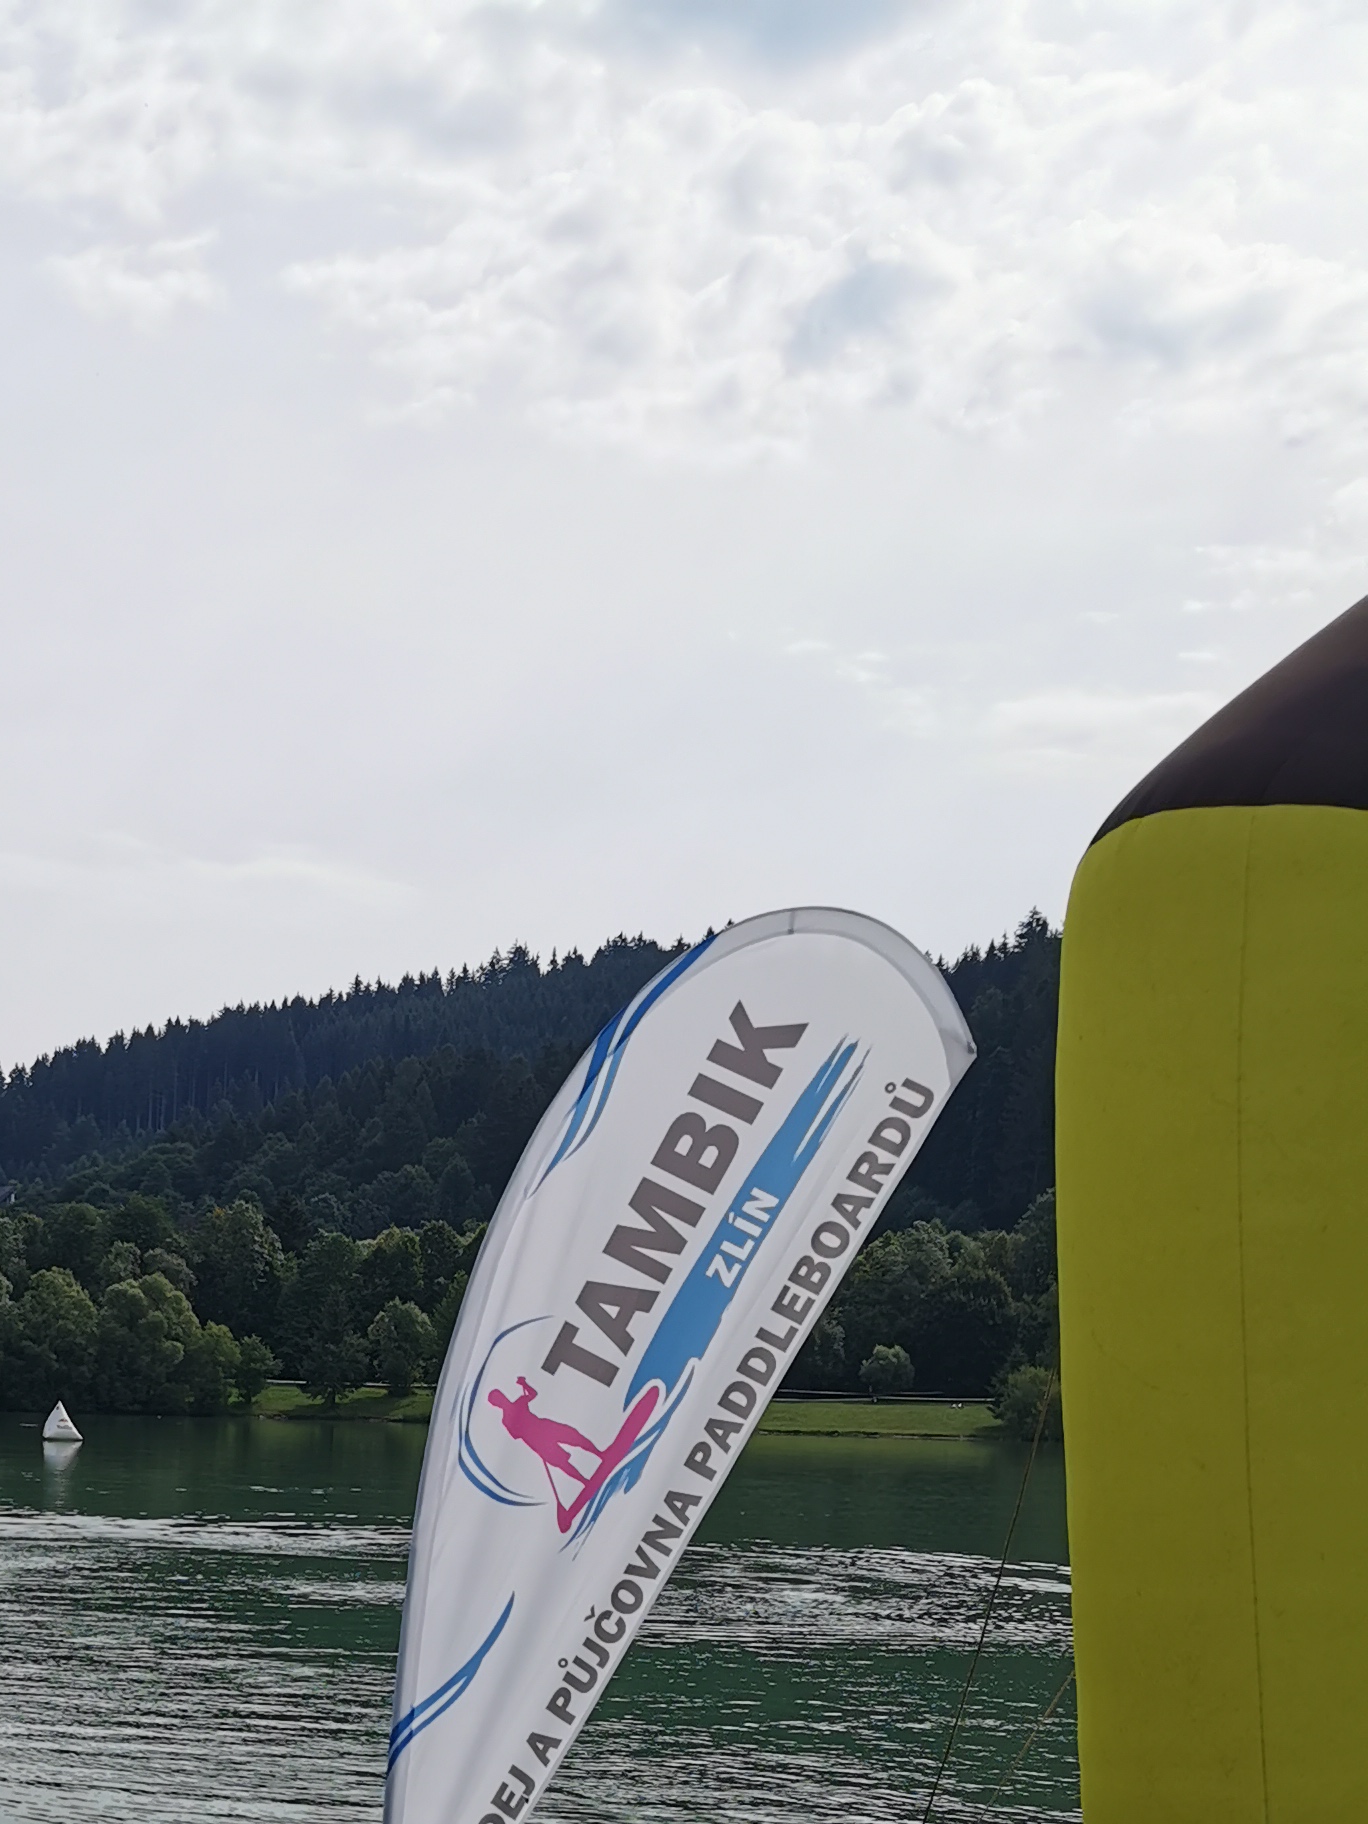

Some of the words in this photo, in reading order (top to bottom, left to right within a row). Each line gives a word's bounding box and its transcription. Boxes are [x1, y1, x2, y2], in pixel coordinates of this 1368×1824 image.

[540, 999, 810, 1388] TAMBIK
[705, 1187, 780, 1289] ZLÍN
[526, 1730, 562, 1767] A
[546, 1486, 702, 1728] PŮJČOVNA
[683, 1077, 935, 1482] PADDLEBOARDŮ
